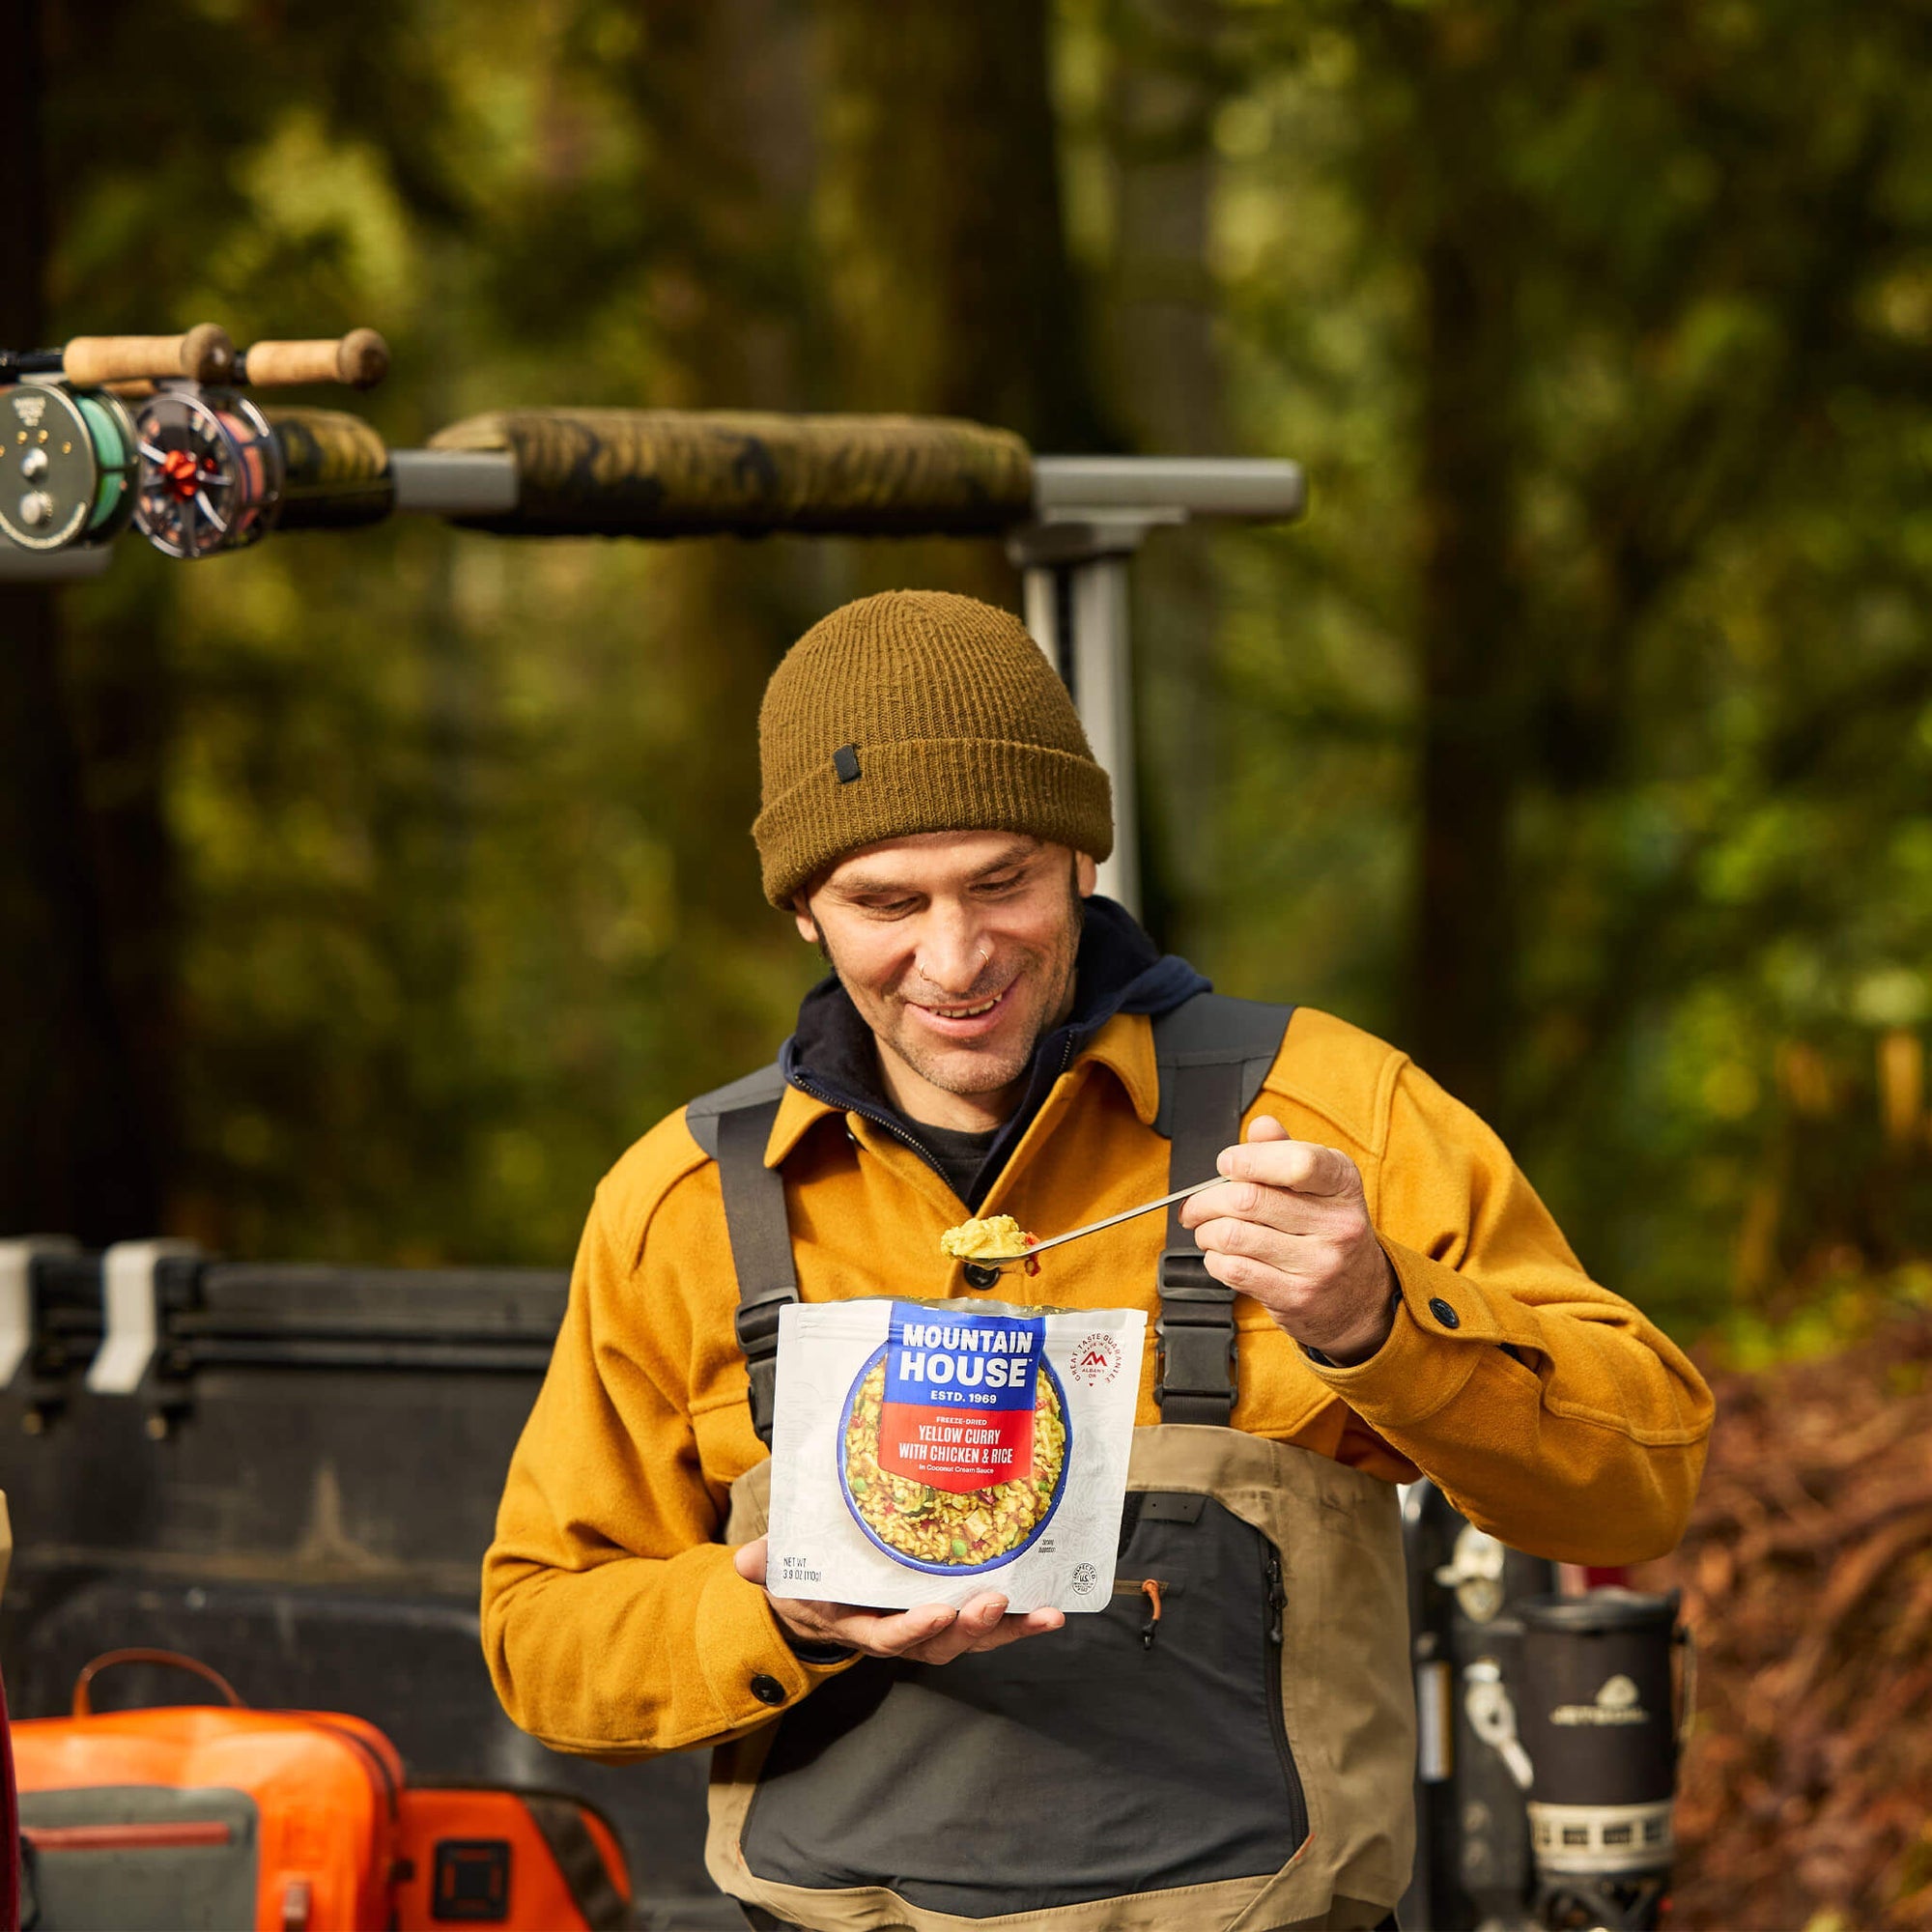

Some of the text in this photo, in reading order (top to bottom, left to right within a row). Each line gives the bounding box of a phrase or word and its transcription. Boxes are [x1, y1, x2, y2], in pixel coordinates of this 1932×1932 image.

[902, 1323, 1034, 1353] MOUNTAIN
[1069, 1351, 1082, 1381] GREAT
[1077, 1333, 1101, 1350] TASTE
[899, 1350, 1028, 1388] HOUSE
[930, 1390, 997, 1405] ESTD. 1969
[936, 1416, 988, 1426] FREEZE-DRIED
[919, 1425, 1001, 1444] YELLOW CURRY
[898, 1442, 1013, 1463] WITH CHICKEN & RICE
[783, 1557, 807, 1568] NET WT
[794, 1570, 803, 1580] OZ
